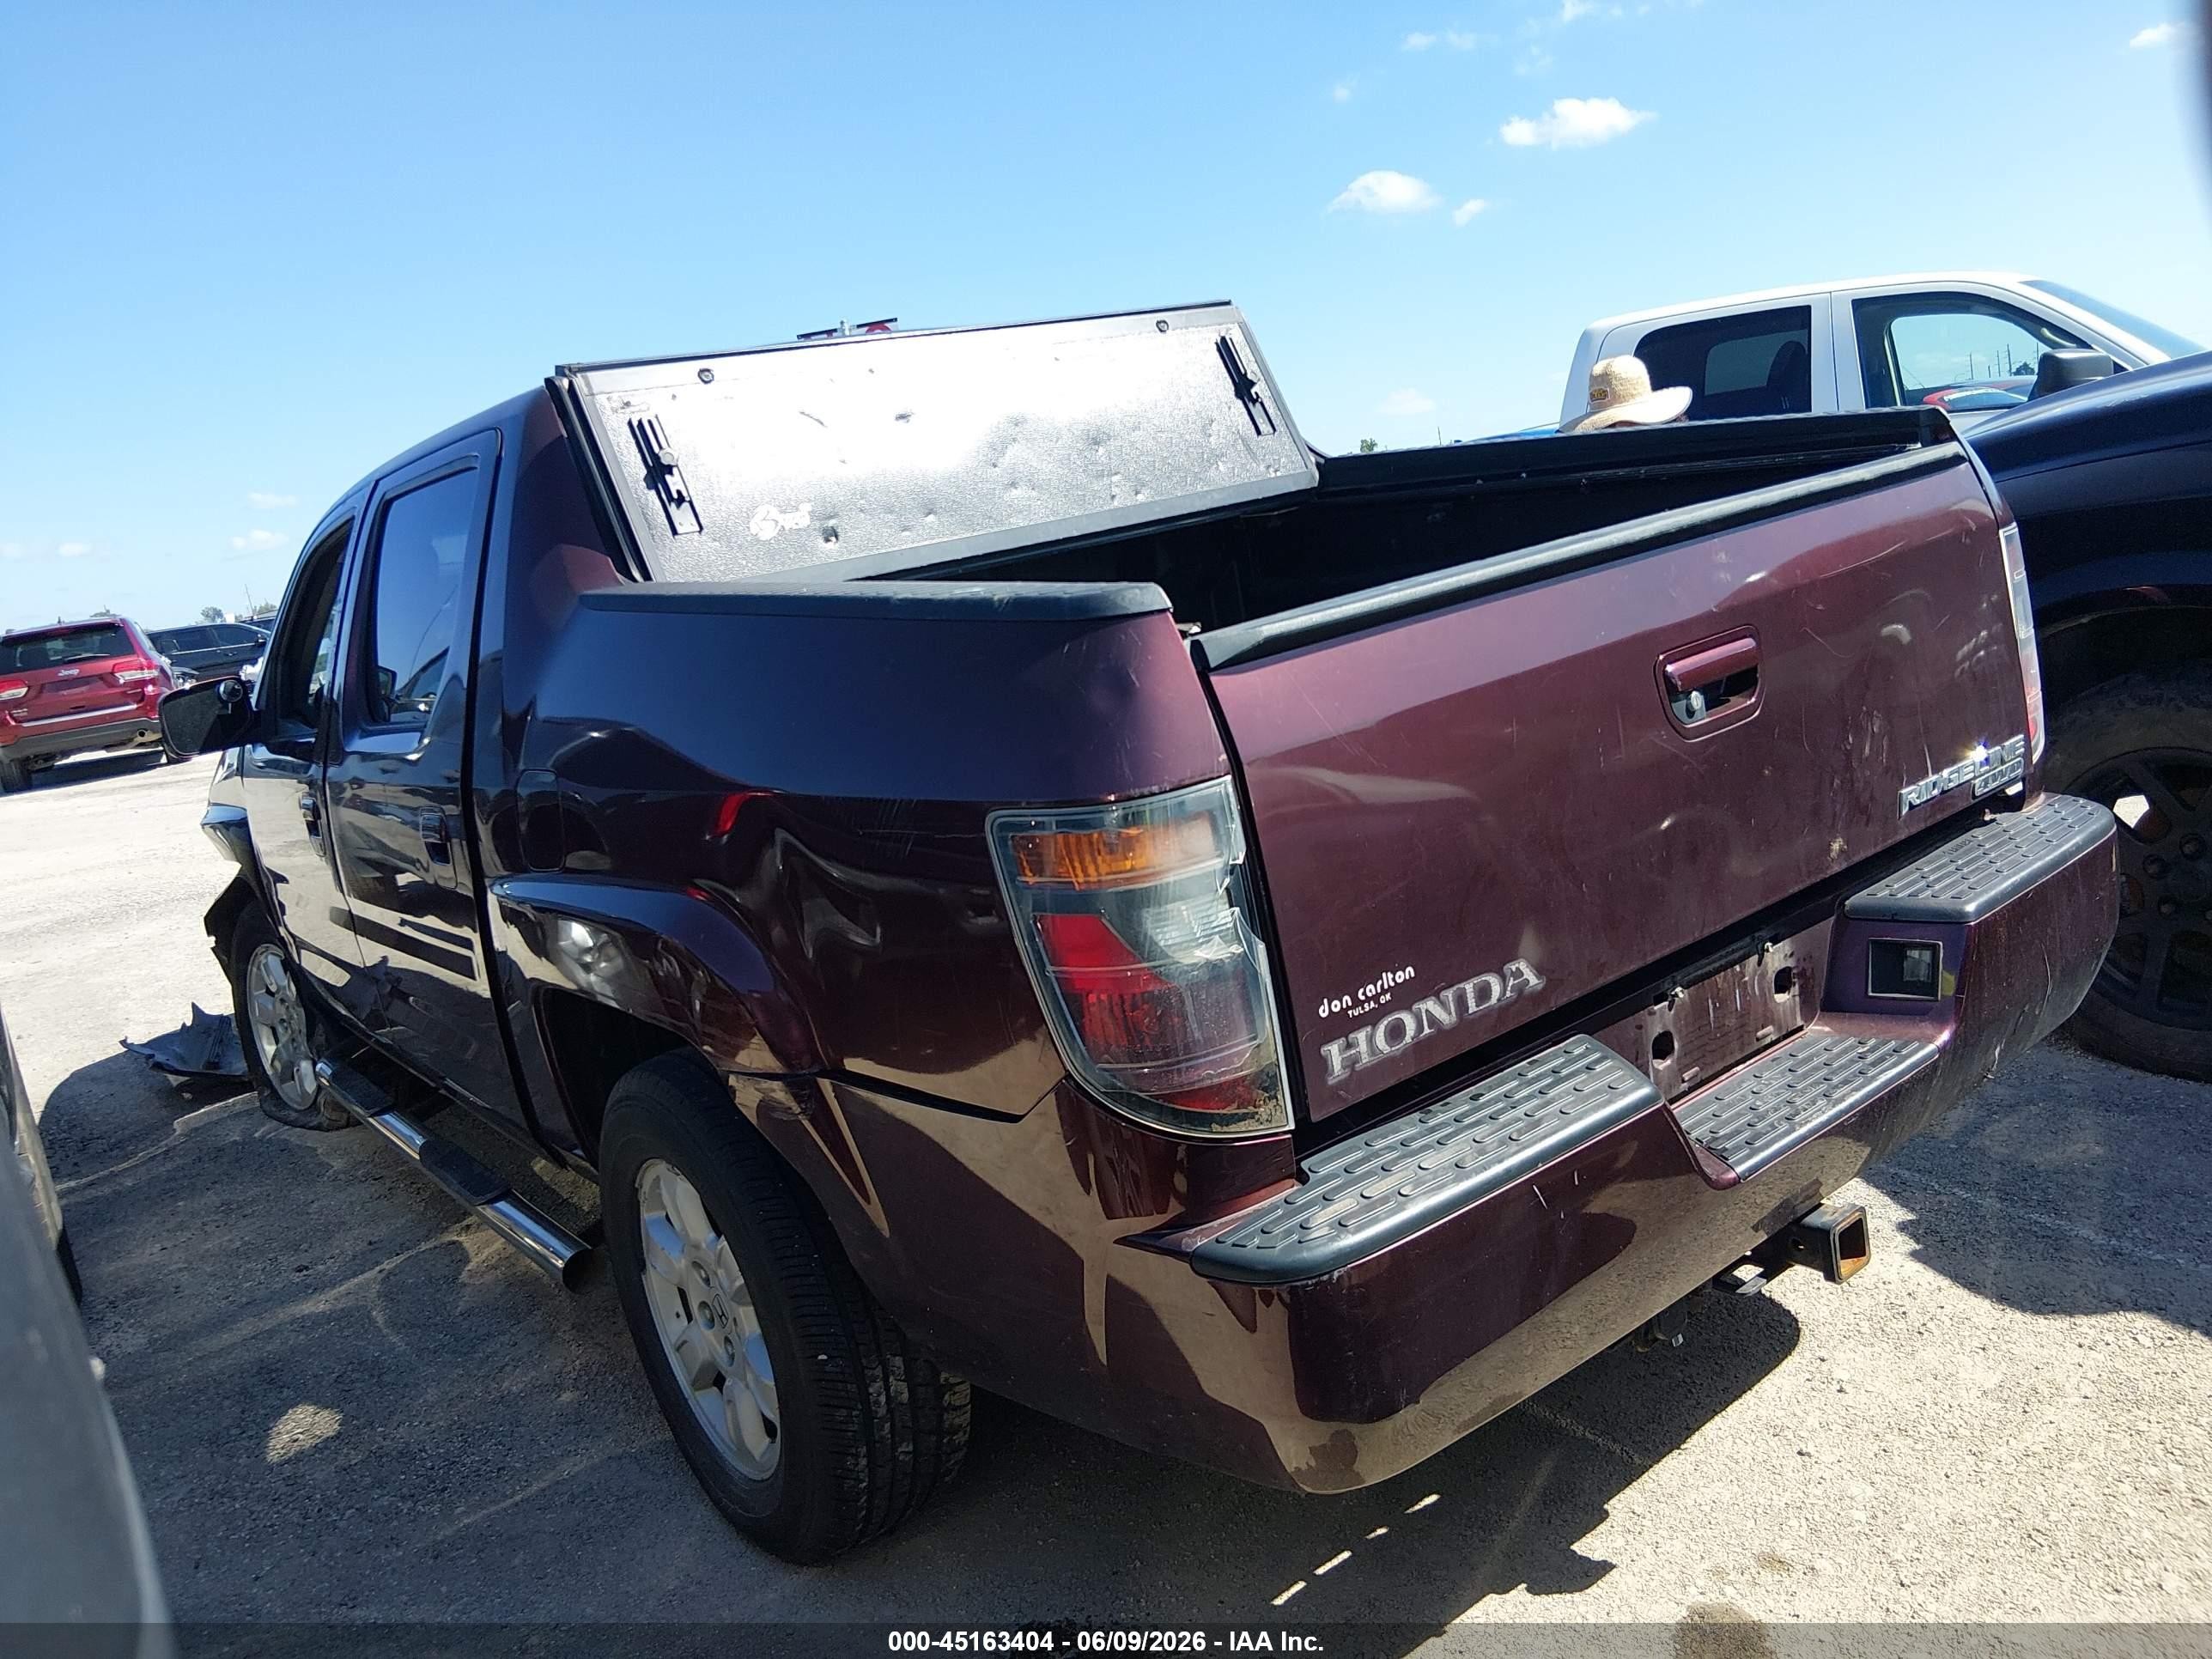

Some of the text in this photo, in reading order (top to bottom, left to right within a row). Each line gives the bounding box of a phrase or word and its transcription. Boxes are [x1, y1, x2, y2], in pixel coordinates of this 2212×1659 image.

[58, 668, 80, 677] Jeep
[1898, 734, 2025, 816] RIDGELINE
[1974, 758, 2024, 796] 4WD
[1318, 965, 1415, 1018] don carlton
[1347, 993, 1392, 1018] TULSA, OK
[1321, 957, 1545, 1085] HONDA
